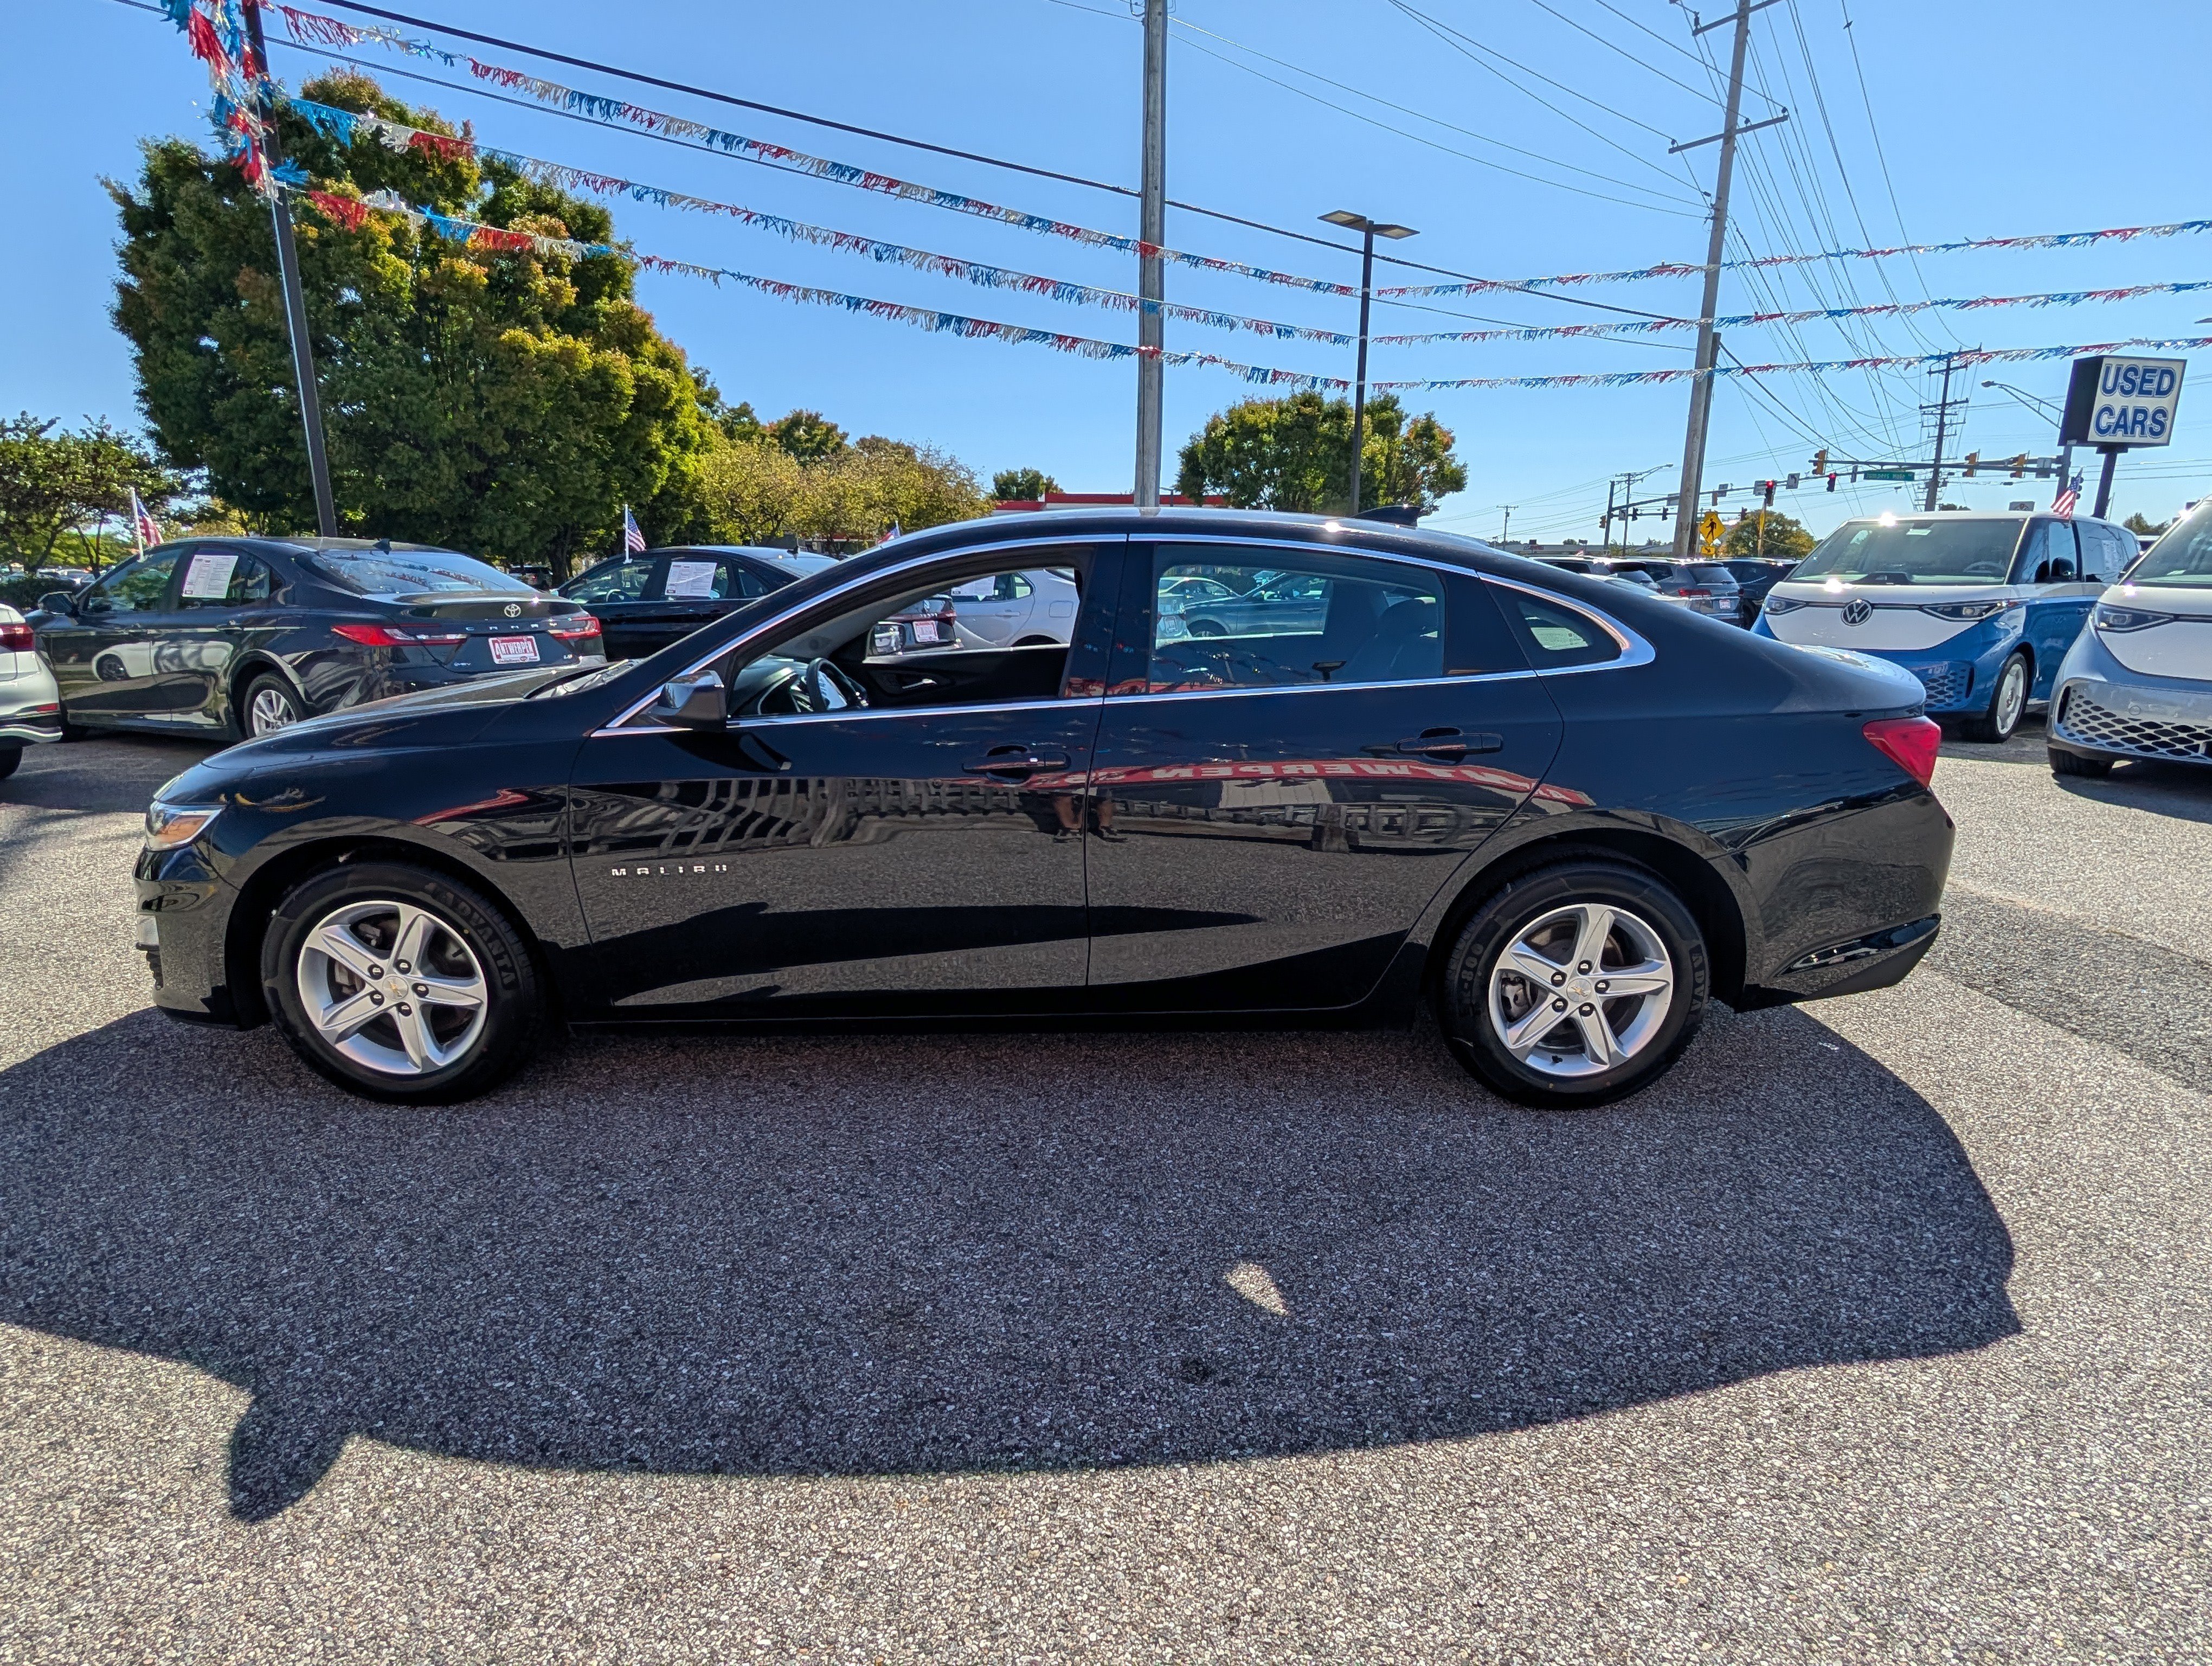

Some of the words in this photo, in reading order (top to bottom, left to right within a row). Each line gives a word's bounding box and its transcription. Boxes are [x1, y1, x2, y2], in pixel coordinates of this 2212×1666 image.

[2101, 364, 2176, 398] USED
[2094, 405, 2169, 439] CARS
[465, 621, 557, 631] CAMRY
[494, 641, 534, 656] ANTWERPEN
[611, 864, 727, 876] MALIBU
